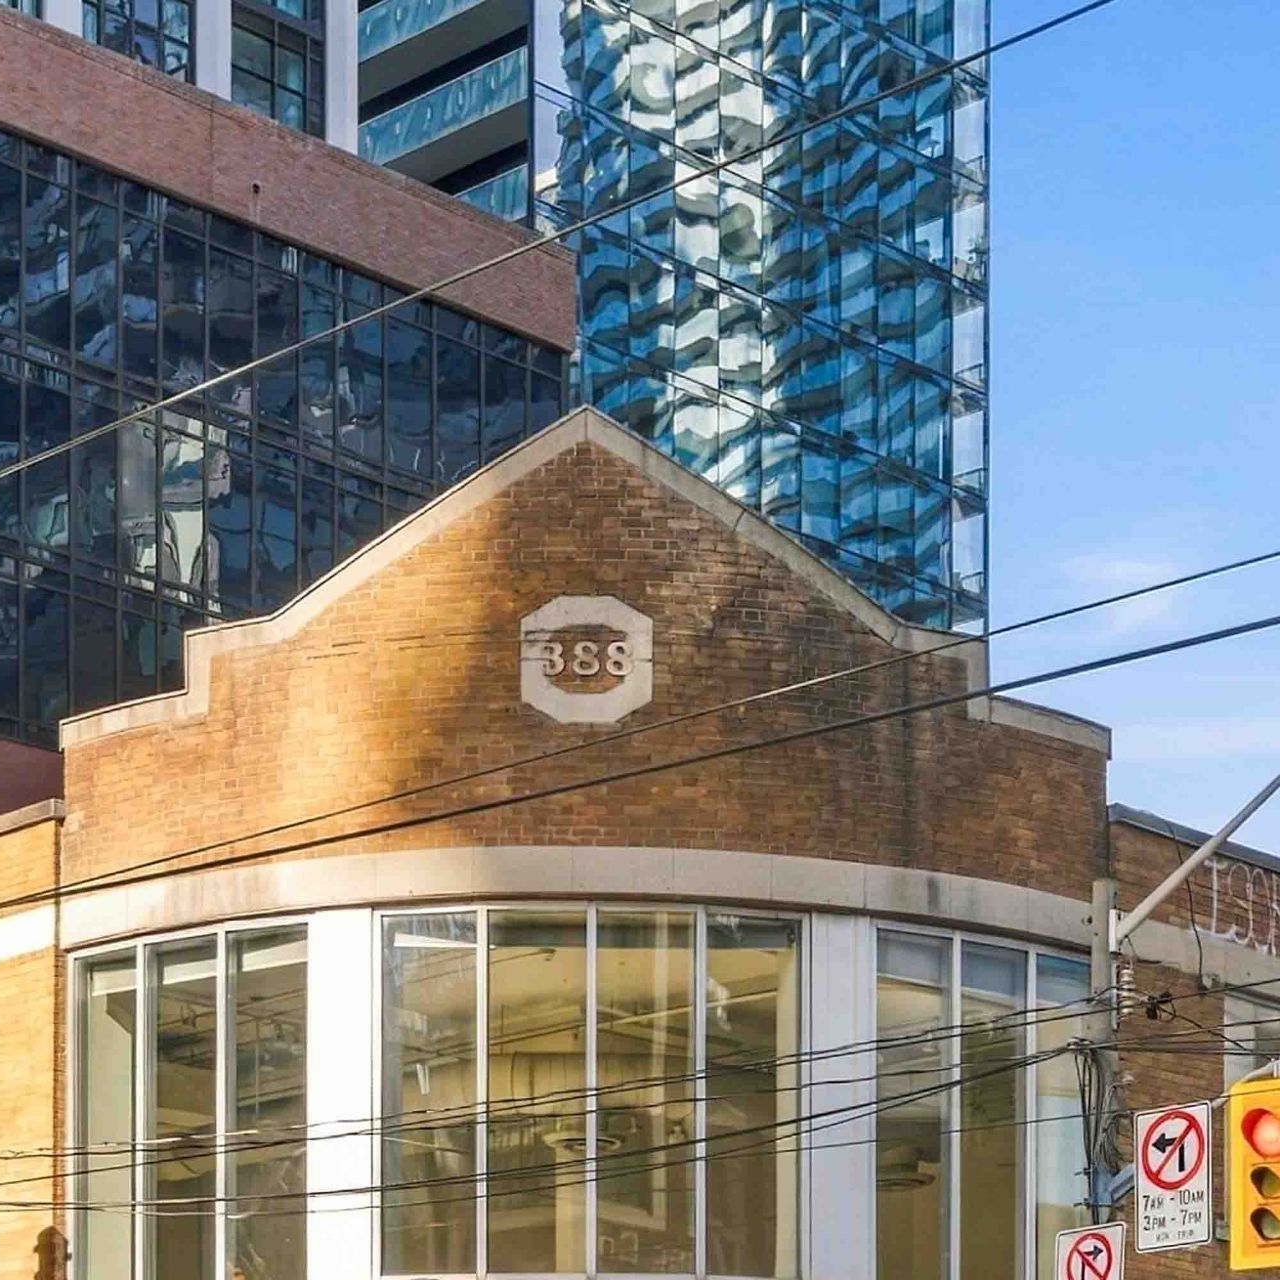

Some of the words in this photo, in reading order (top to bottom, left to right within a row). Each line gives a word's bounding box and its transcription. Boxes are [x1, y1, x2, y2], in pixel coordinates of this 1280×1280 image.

[543, 641, 634, 676] 388
[1142, 1194, 1165, 1211] 7AM
[1179, 1189, 1205, 1206] 10AM
[1143, 1215, 1166, 1231] 3PM
[1180, 1209, 1202, 1226] 7PM
